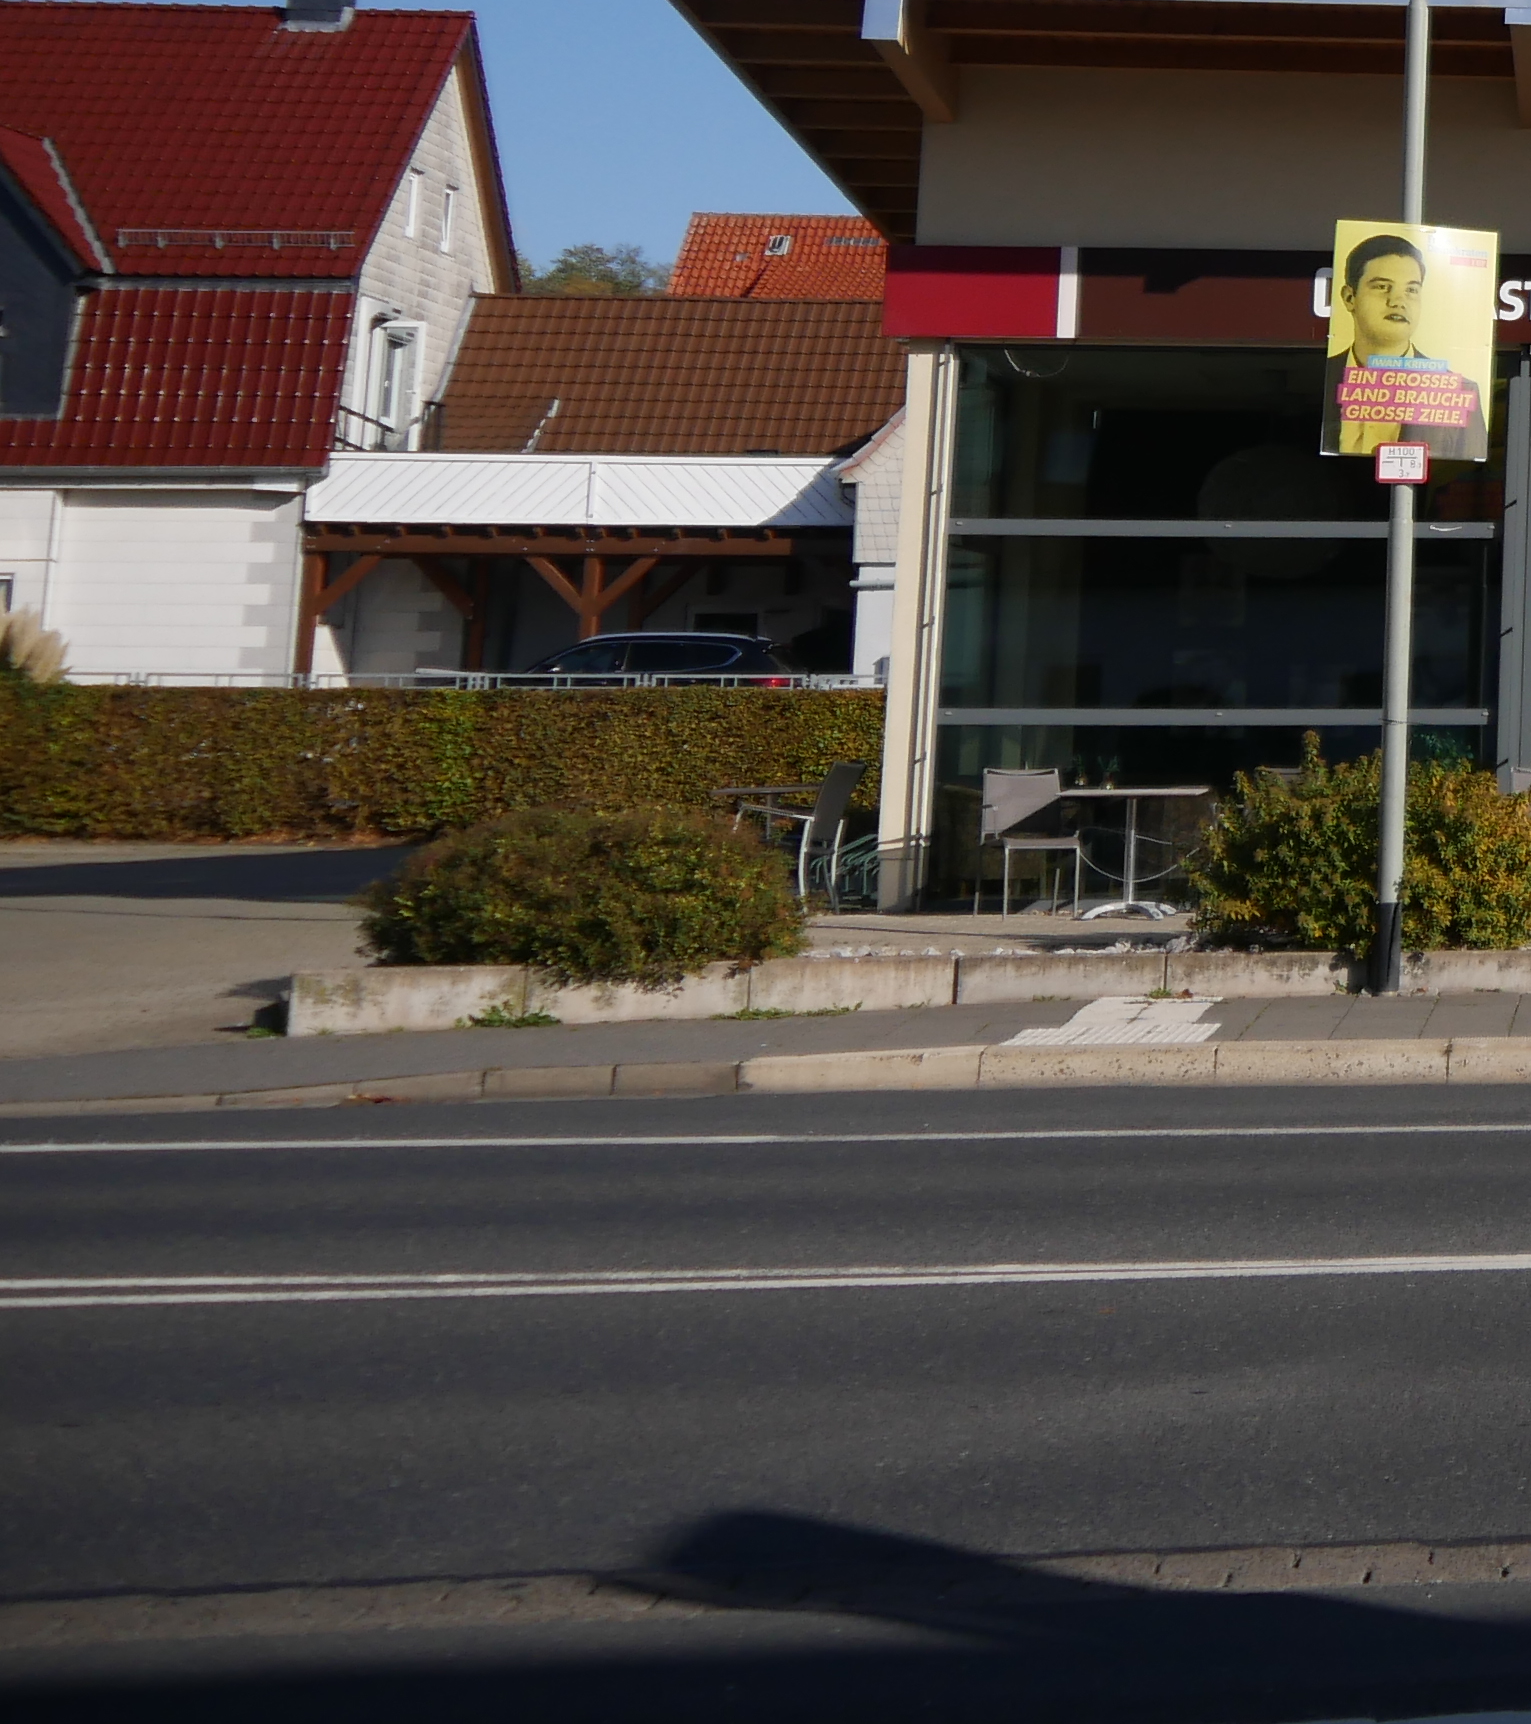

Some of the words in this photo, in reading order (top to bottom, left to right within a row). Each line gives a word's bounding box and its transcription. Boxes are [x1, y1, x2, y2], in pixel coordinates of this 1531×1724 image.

[1371, 357, 1402, 368] IWAN
[1404, 359, 1446, 371] KRIVOV
[1347, 370, 1378, 385] EIN
[1381, 372, 1459, 390] GROSSES
[1341, 388, 1391, 402] LAND
[1394, 389, 1474, 408] BRAUCHT
[1345, 405, 1415, 421] GROSSE
[1417, 409, 1465, 424] ZIELE.
